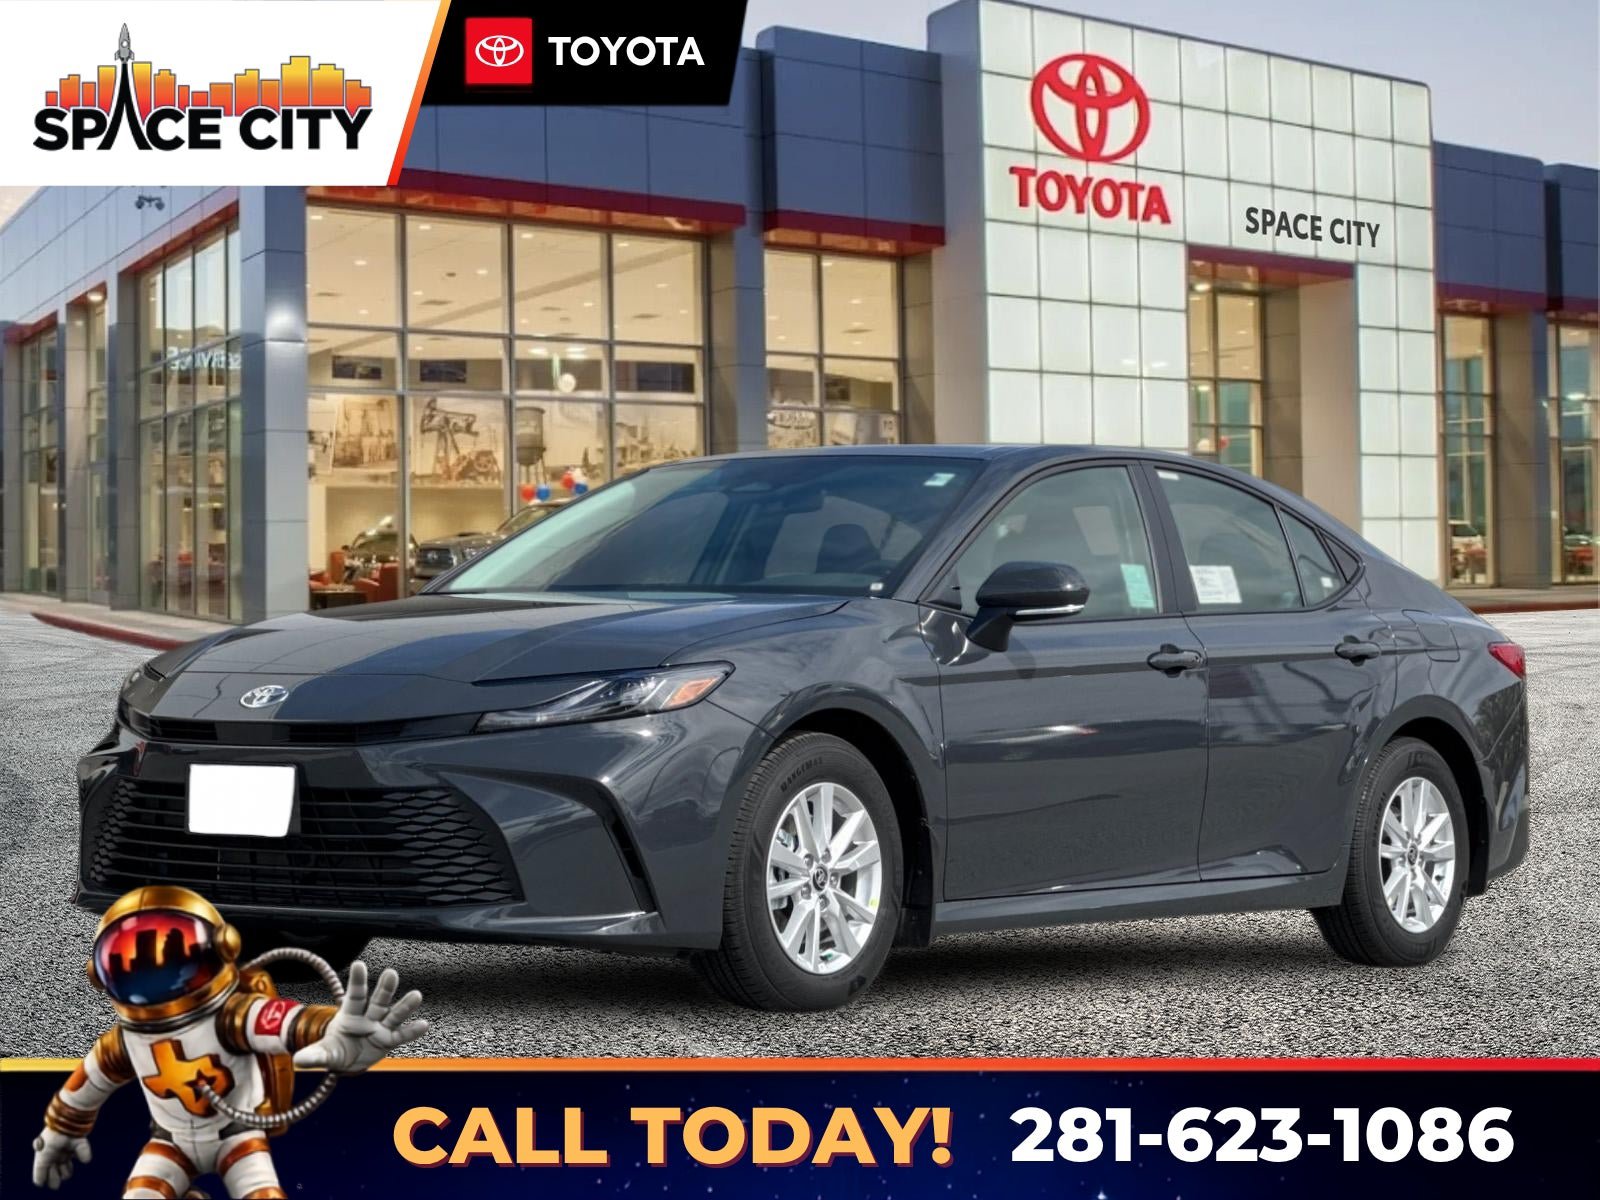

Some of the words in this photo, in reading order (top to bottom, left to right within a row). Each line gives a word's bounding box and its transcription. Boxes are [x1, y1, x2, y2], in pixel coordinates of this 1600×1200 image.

[1010, 166, 1171, 225] TOYOTA
[1245, 206, 1322, 242] SPACE
[1330, 218, 1381, 249] CITY
